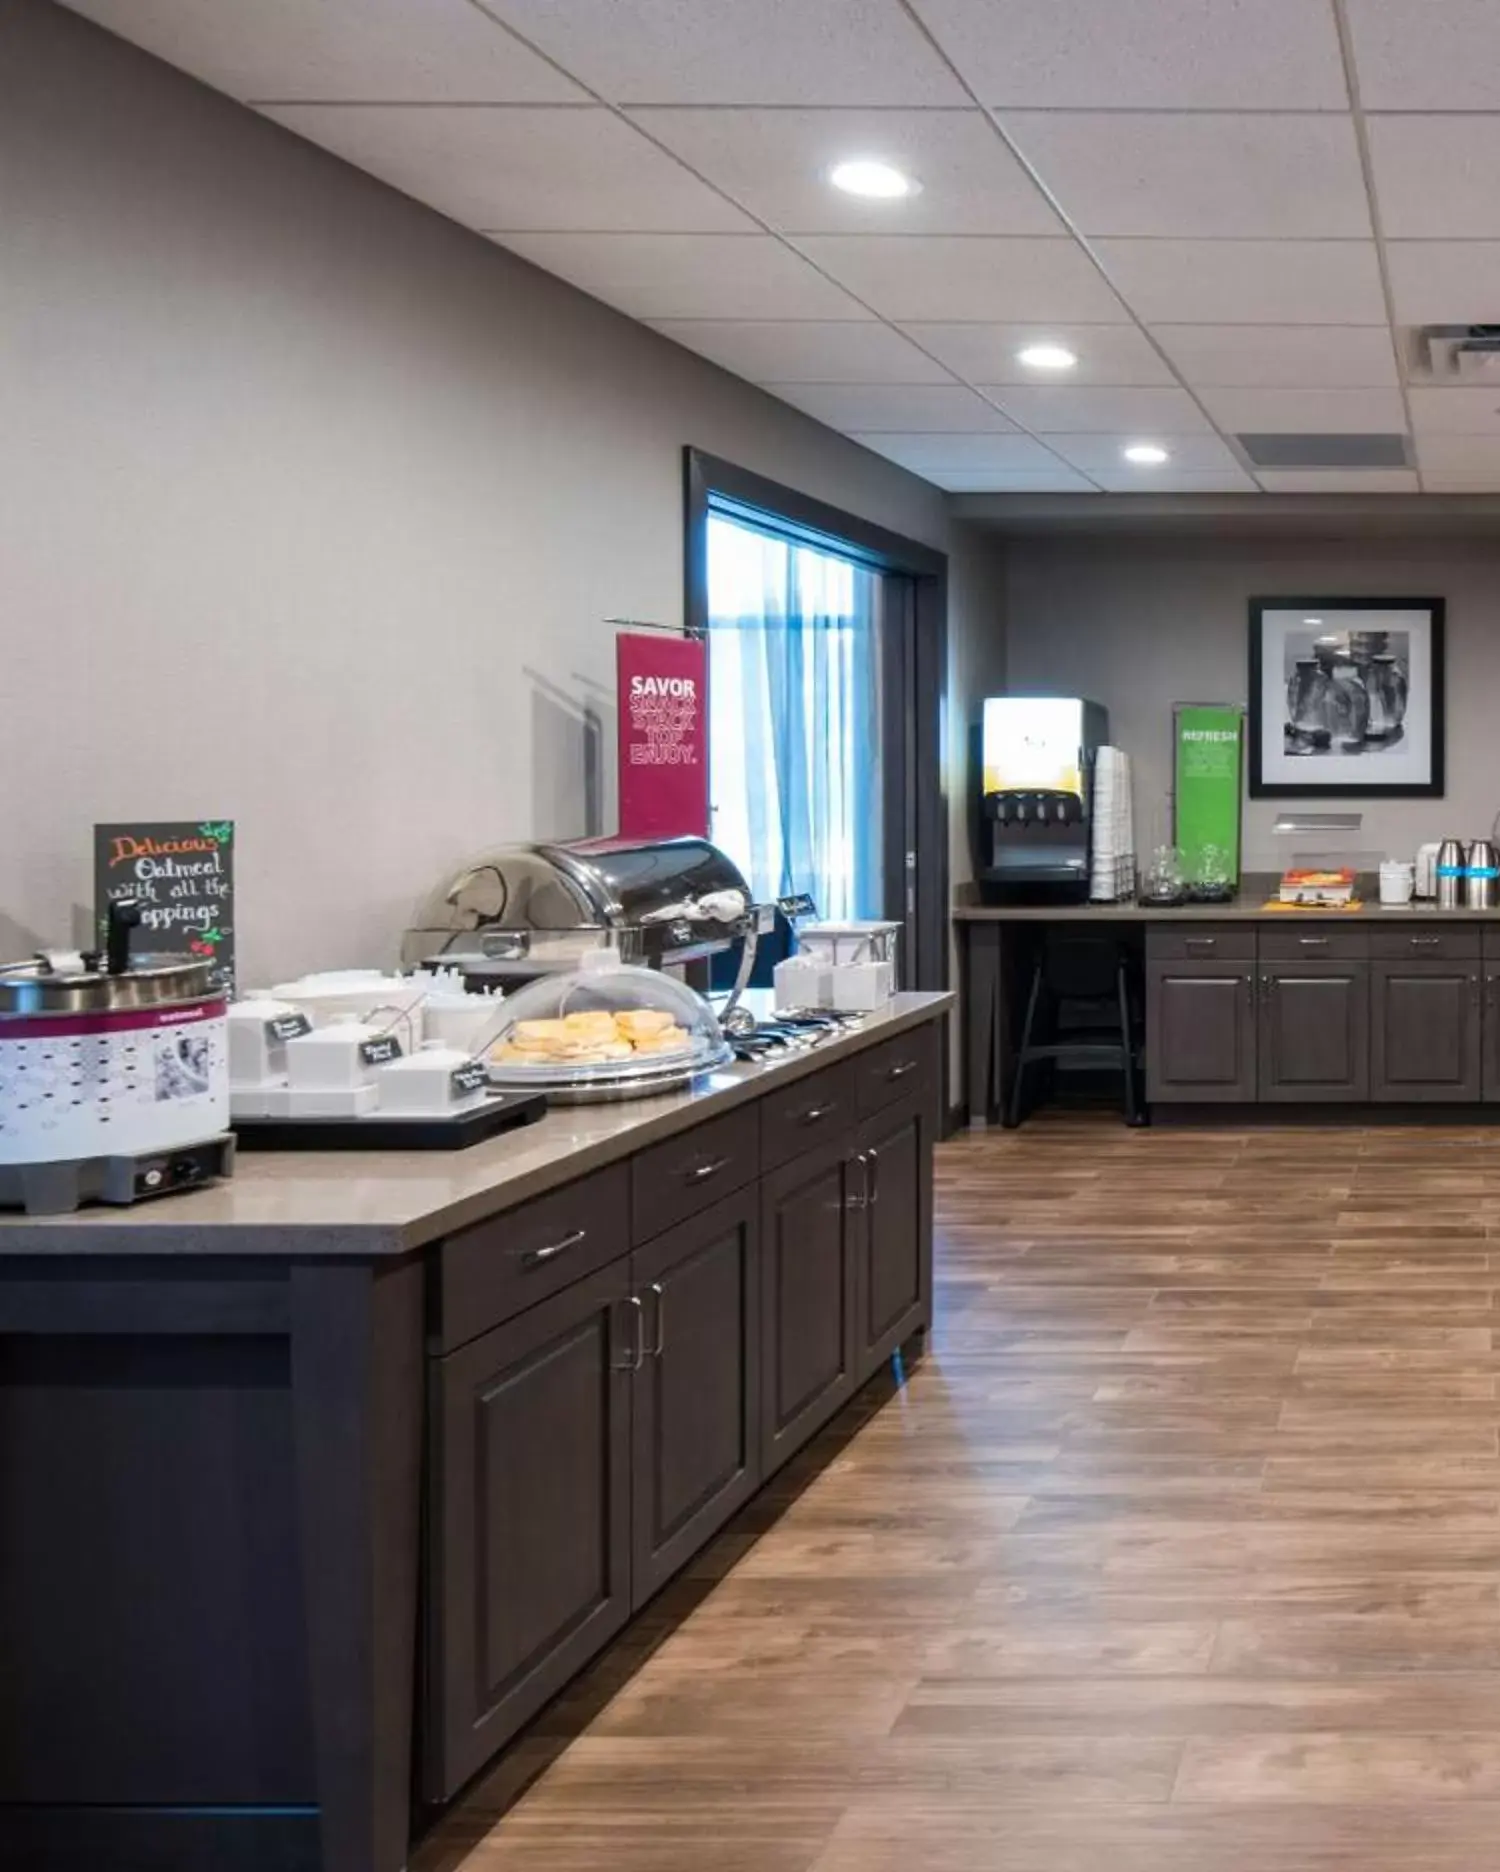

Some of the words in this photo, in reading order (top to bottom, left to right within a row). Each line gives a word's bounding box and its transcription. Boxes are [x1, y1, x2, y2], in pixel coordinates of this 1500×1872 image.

[631, 675, 697, 699] SAVOR
[1182, 729, 1238, 742] REFRESH
[108, 836, 219, 867] Delicious
[134, 852, 224, 880] Oatmeal
[106, 880, 160, 902] with
[169, 880, 199, 898] all
[205, 877, 232, 899] the
[140, 902, 219, 934] oppings
